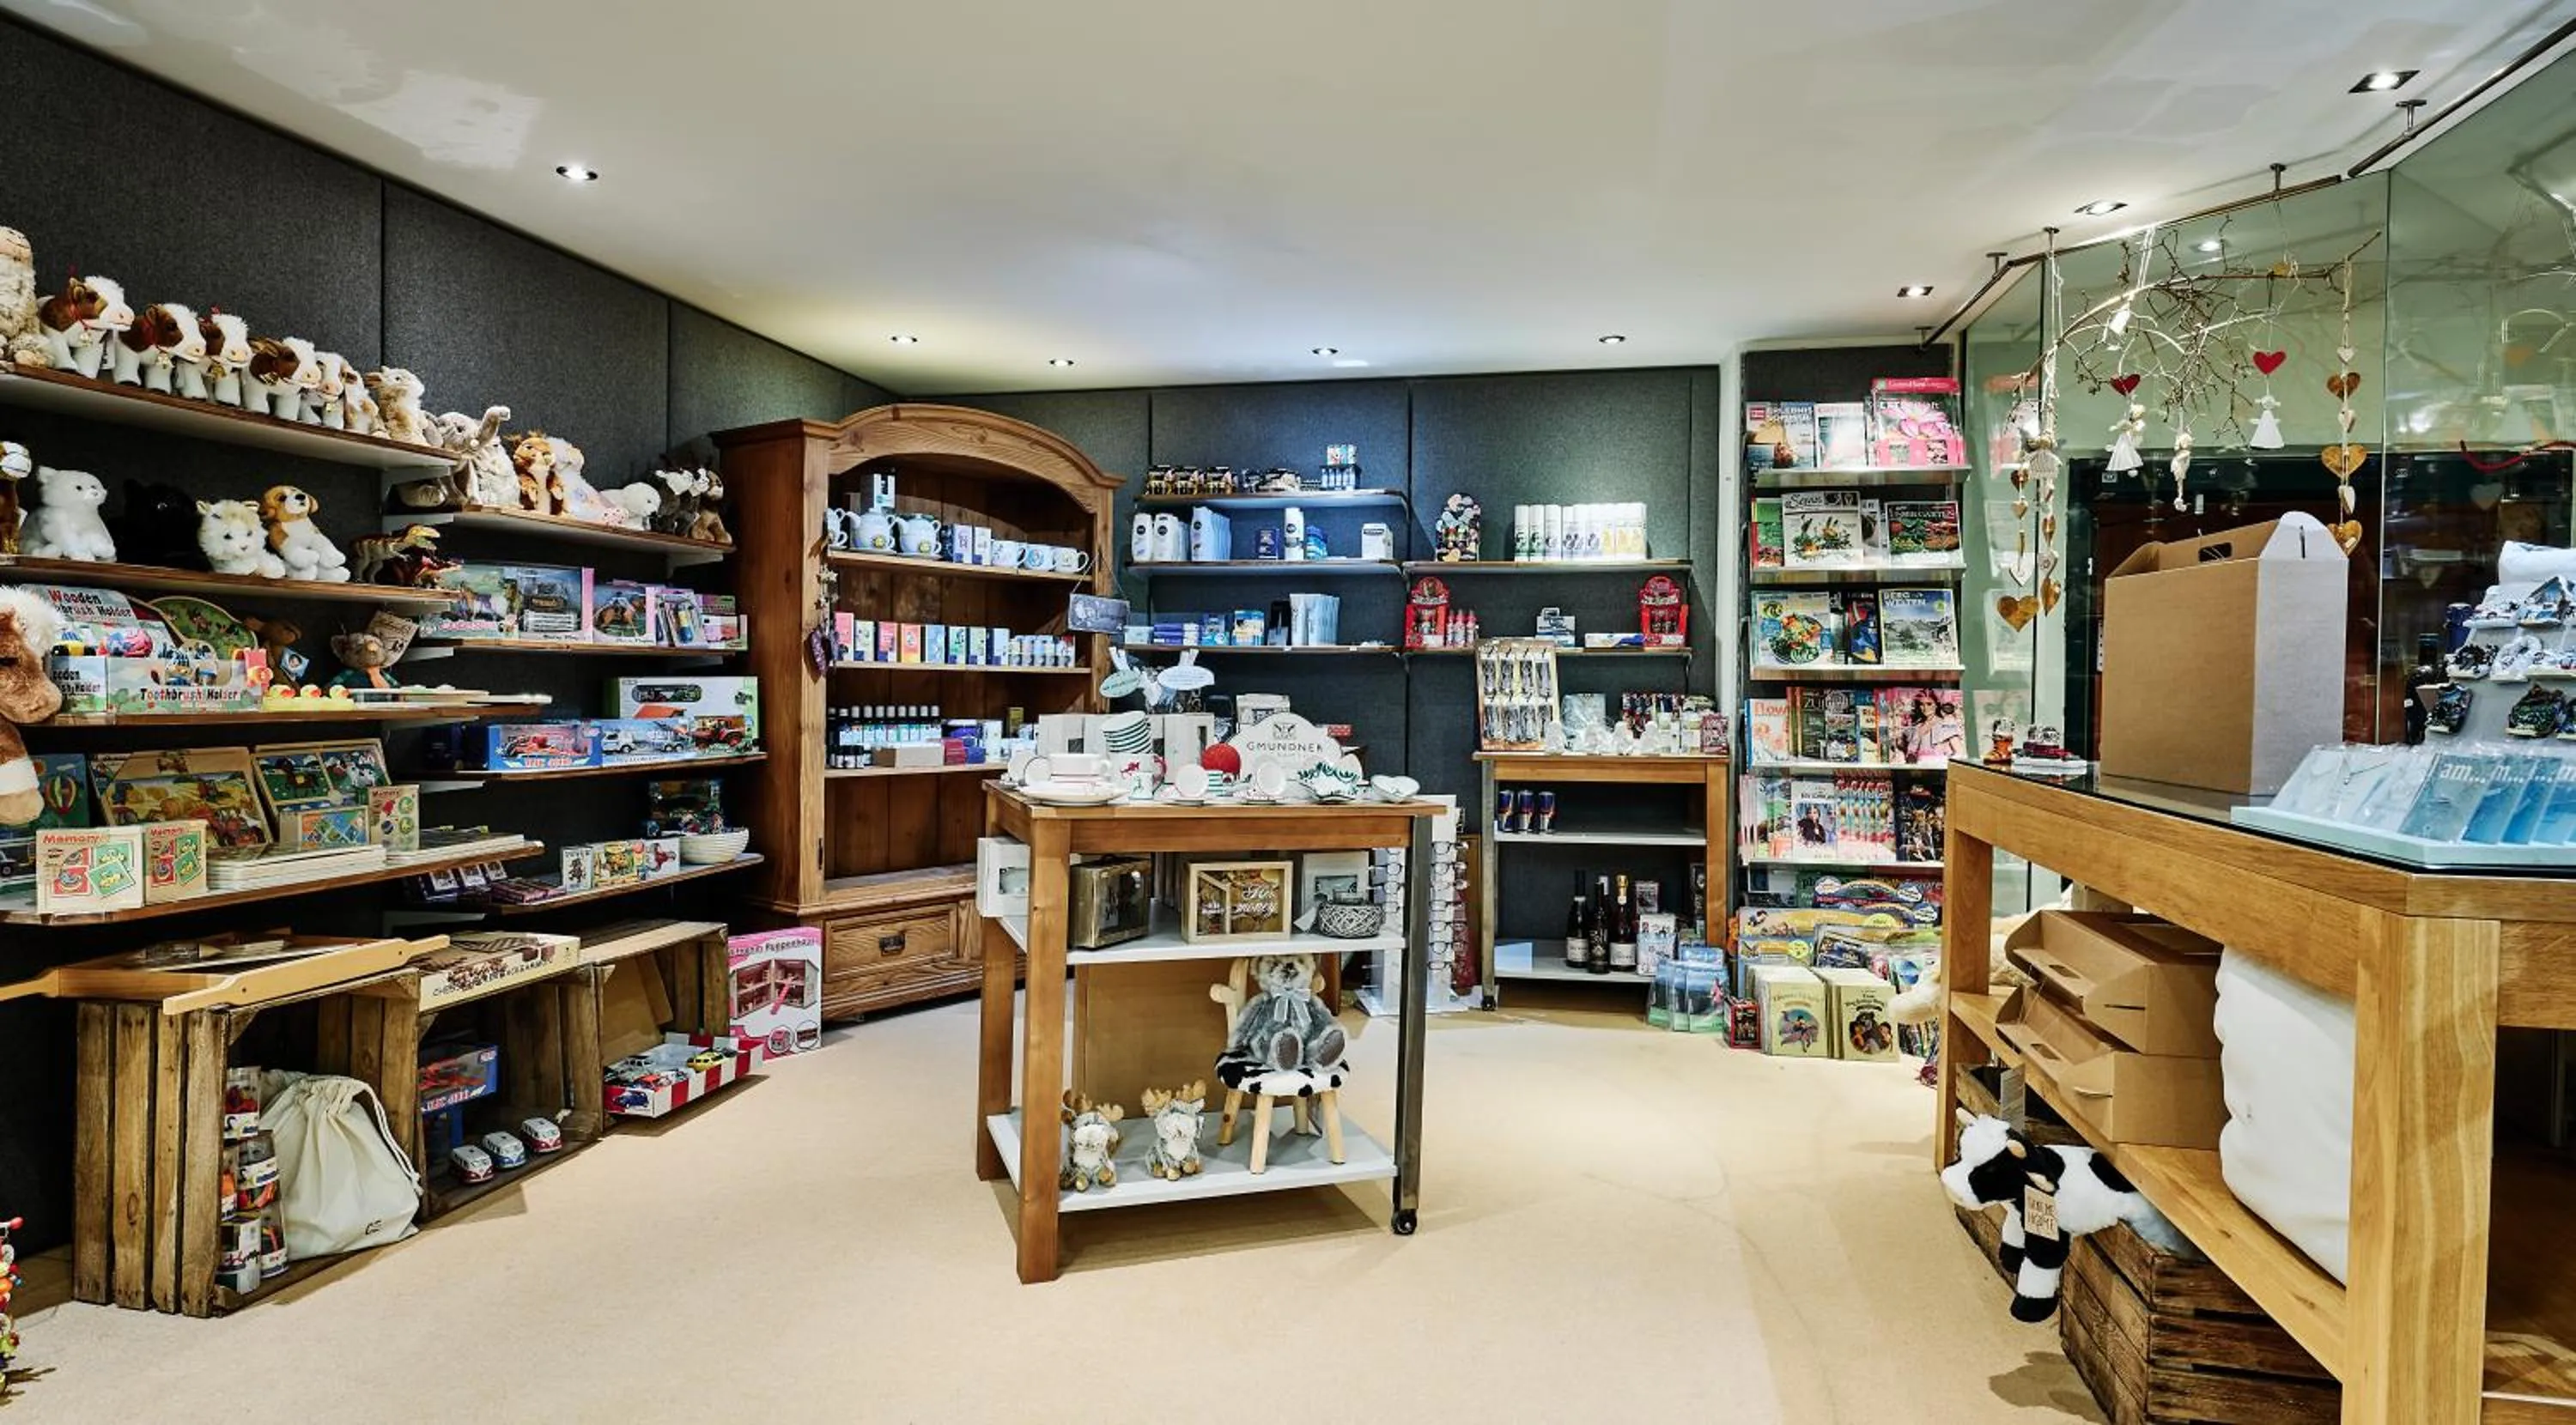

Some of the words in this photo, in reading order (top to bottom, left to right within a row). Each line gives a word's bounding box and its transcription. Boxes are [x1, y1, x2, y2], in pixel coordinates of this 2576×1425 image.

[48, 589, 101, 605] Wooden
[52, 669, 81, 682] ooden
[140, 688, 204, 701] Toothbrush
[207, 688, 241, 701] Holder
[1247, 741, 1323, 753] GMUNDNER
